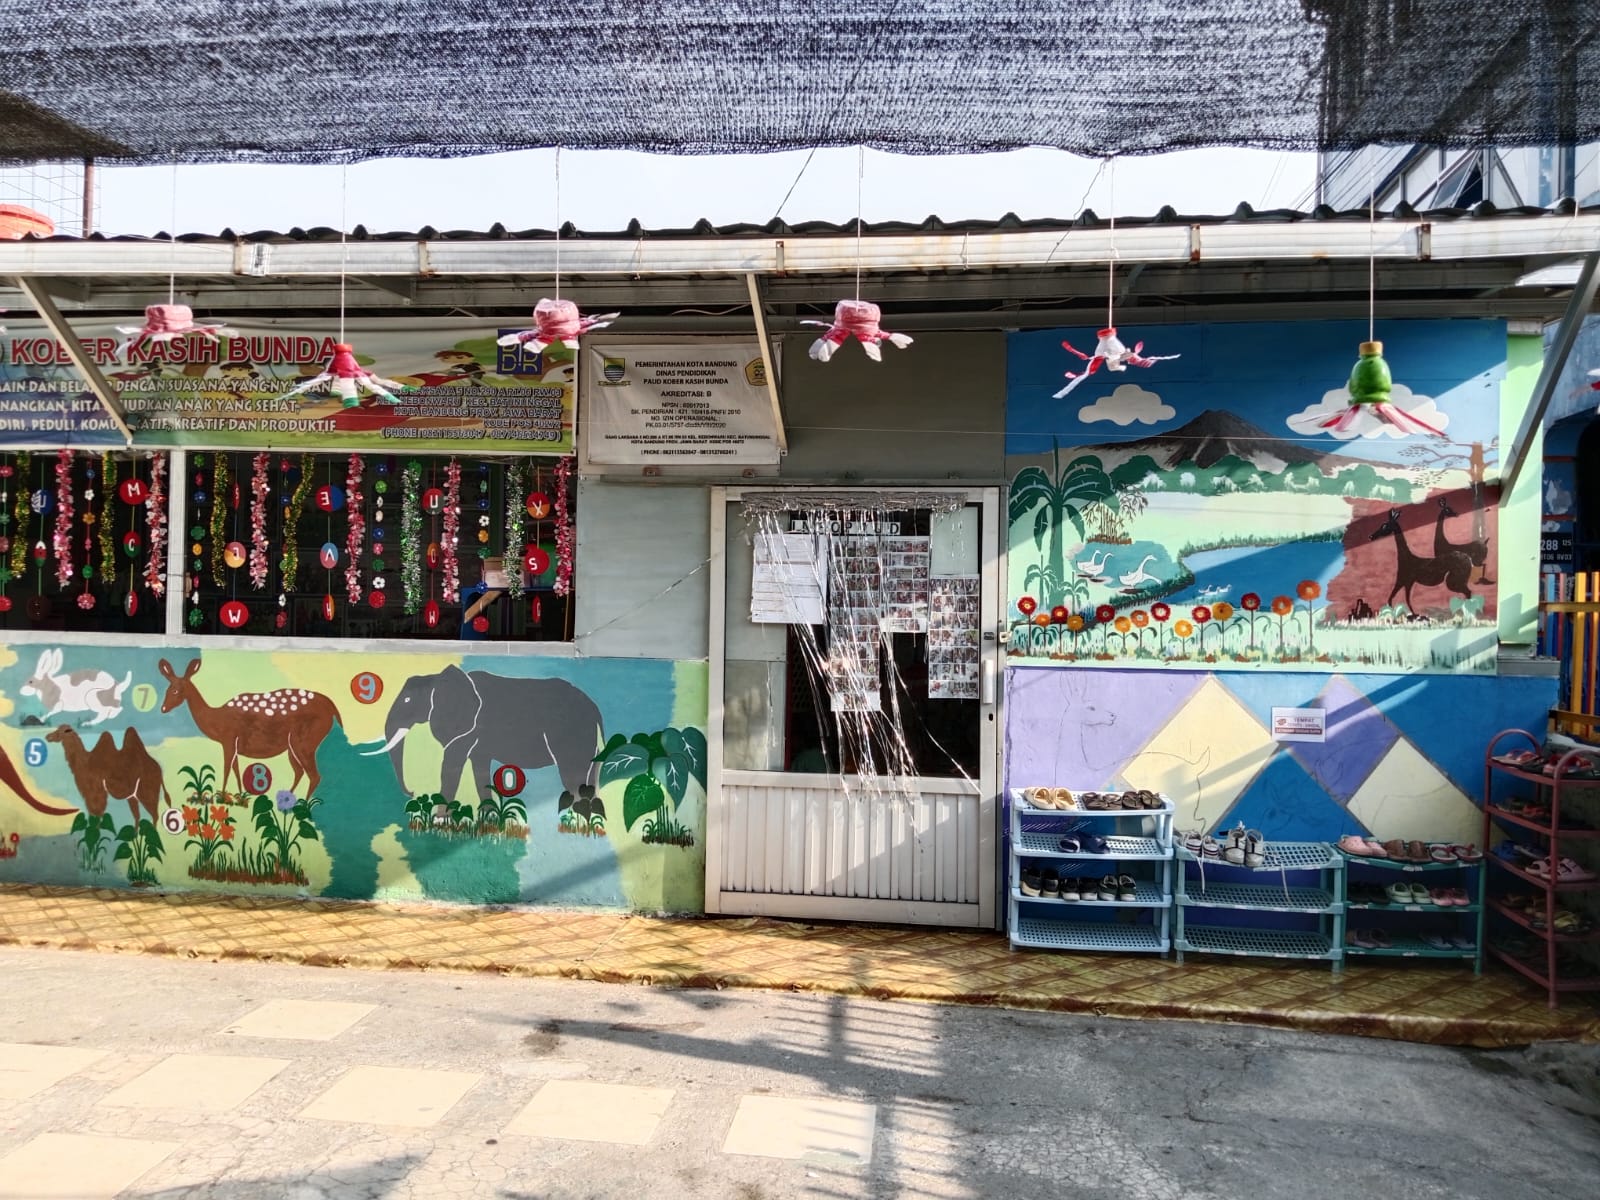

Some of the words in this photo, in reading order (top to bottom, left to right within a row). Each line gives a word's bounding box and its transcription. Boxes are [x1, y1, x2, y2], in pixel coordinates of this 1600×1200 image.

[127, 336, 219, 363] KASIH
[227, 336, 336, 363] BUNDA
[0, 381, 25, 393] AIN
[29, 381, 57, 393] DAN
[60, 381, 112, 393] BELA
[116, 381, 165, 393] DENGAN
[168, 380, 226, 393] SUASANA
[230, 381, 268, 393] YANG
[71, 400, 100, 412] KITA
[104, 399, 172, 412] JUDKAN
[174, 400, 212, 412] ANAK
[216, 400, 252, 412] YANG
[256, 400, 302, 415] SEHAT,
[420, 407, 469, 417] BANDUNG
[528, 409, 562, 420] BARAT
[80, 419, 172, 432] KOMUATIF,
[174, 418, 226, 431] KREATIF
[228, 419, 258, 431] DAN
[261, 419, 337, 432] PRODUKTIF
[846, 521, 900, 535] PUD
[137, 687, 149, 709] 7
[358, 674, 377, 701] 9
[27, 741, 42, 765] 5
[252, 763, 268, 791] 8
[165, 810, 179, 832] 6
